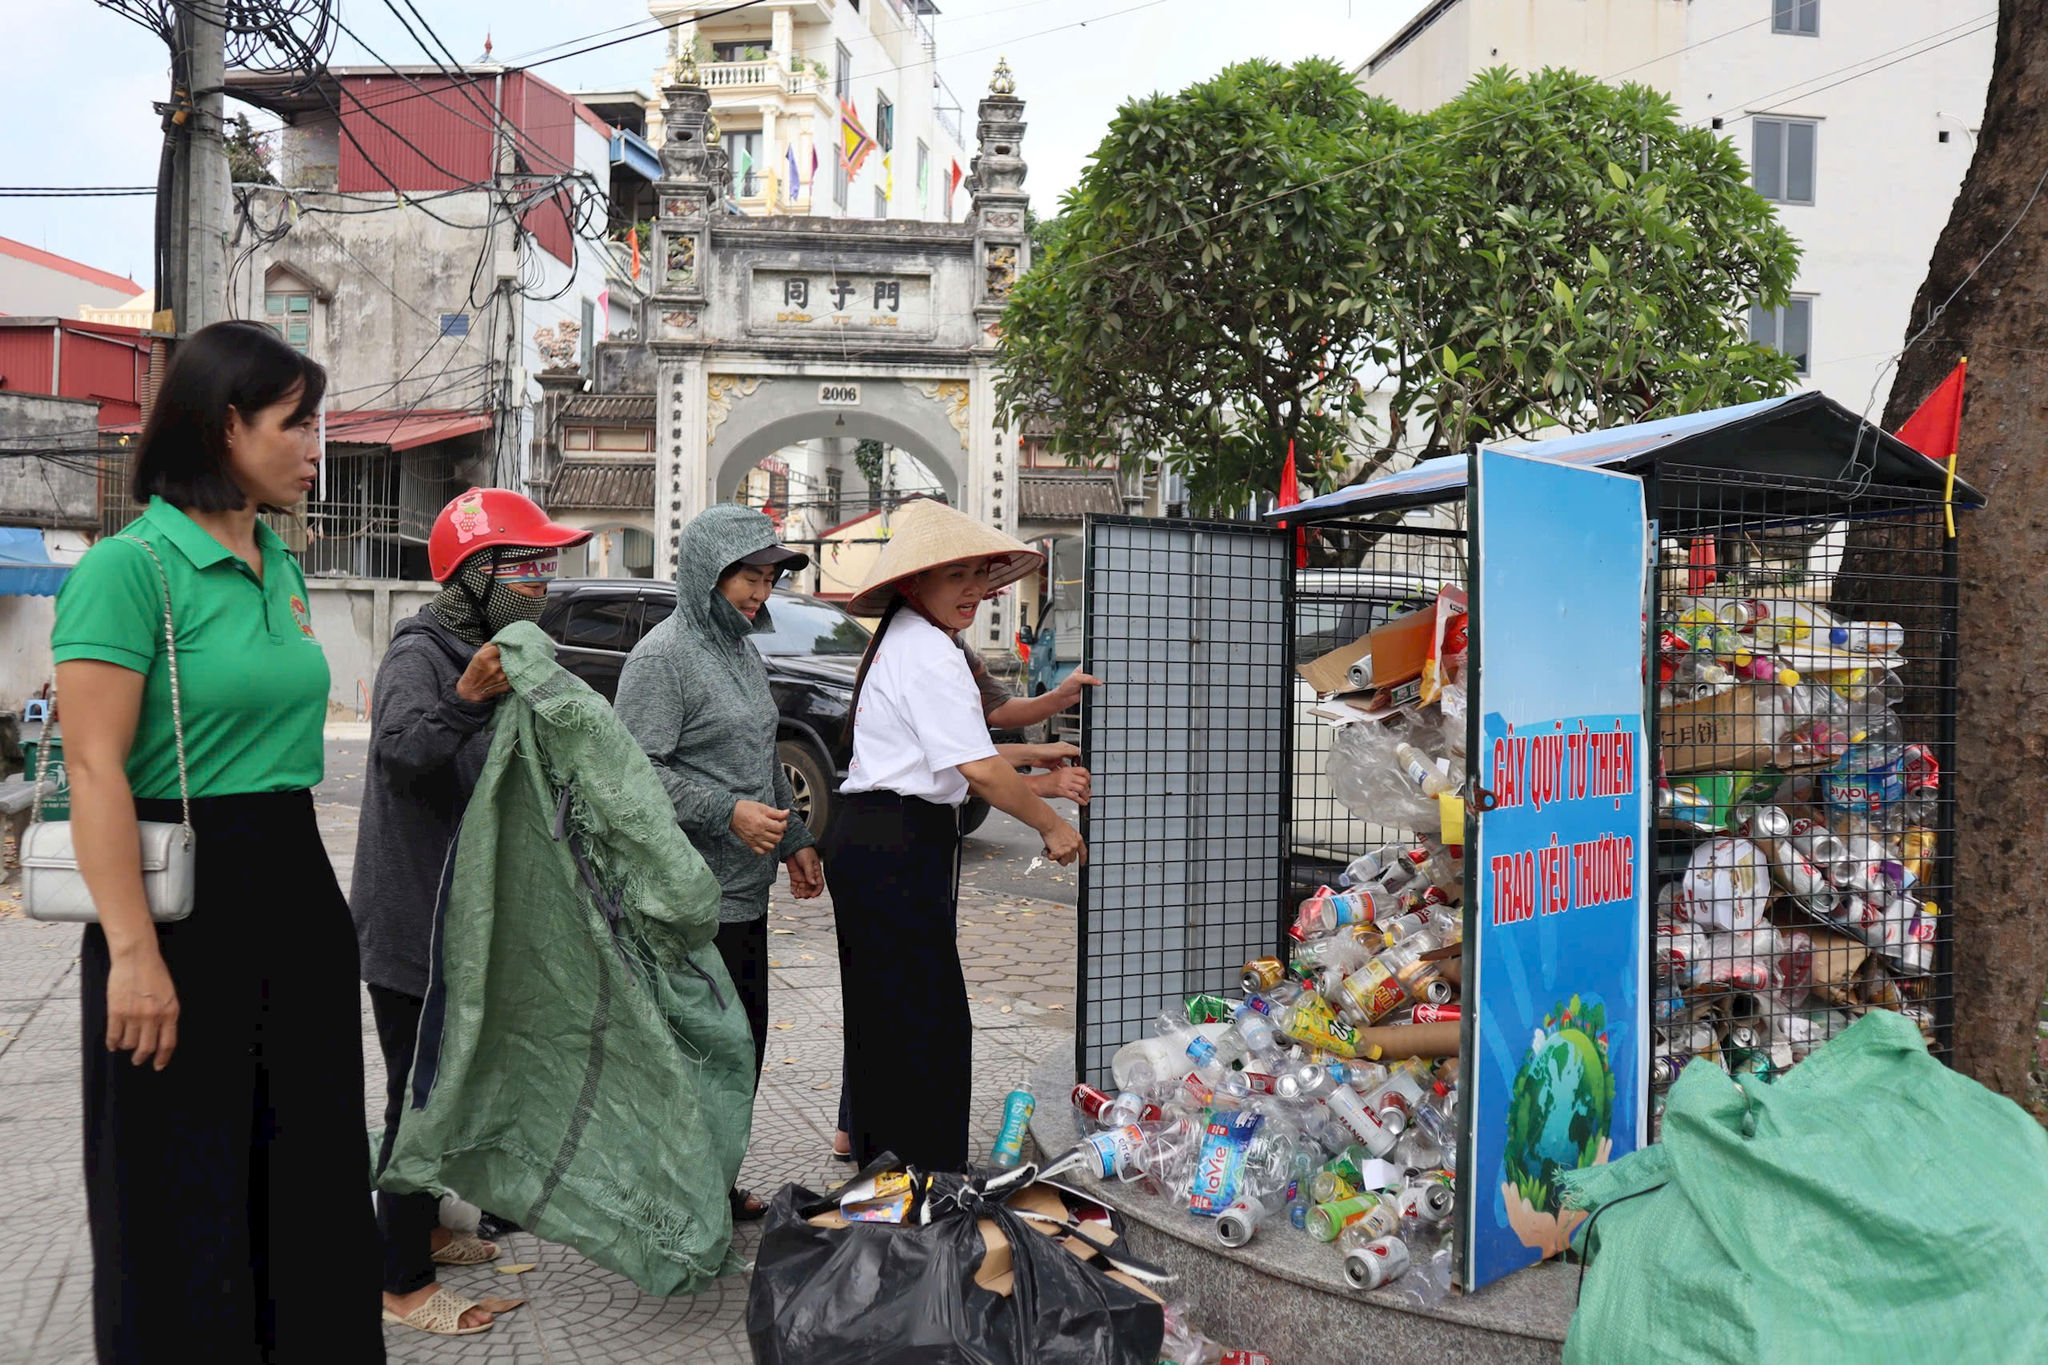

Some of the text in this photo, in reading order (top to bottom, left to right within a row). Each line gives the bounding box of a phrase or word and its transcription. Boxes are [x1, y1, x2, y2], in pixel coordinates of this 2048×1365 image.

[822, 386, 858, 402] 2006
[1493, 718, 1634, 812] GÂY QUỸ TỪ THIỆN
[1492, 832, 1634, 926] TRAO YÊU THƯƠNG
[1374, 985, 1393, 1010] GOLD
[1340, 1116, 1368, 1146] HANOI
[1205, 1146, 1227, 1195] laVie
